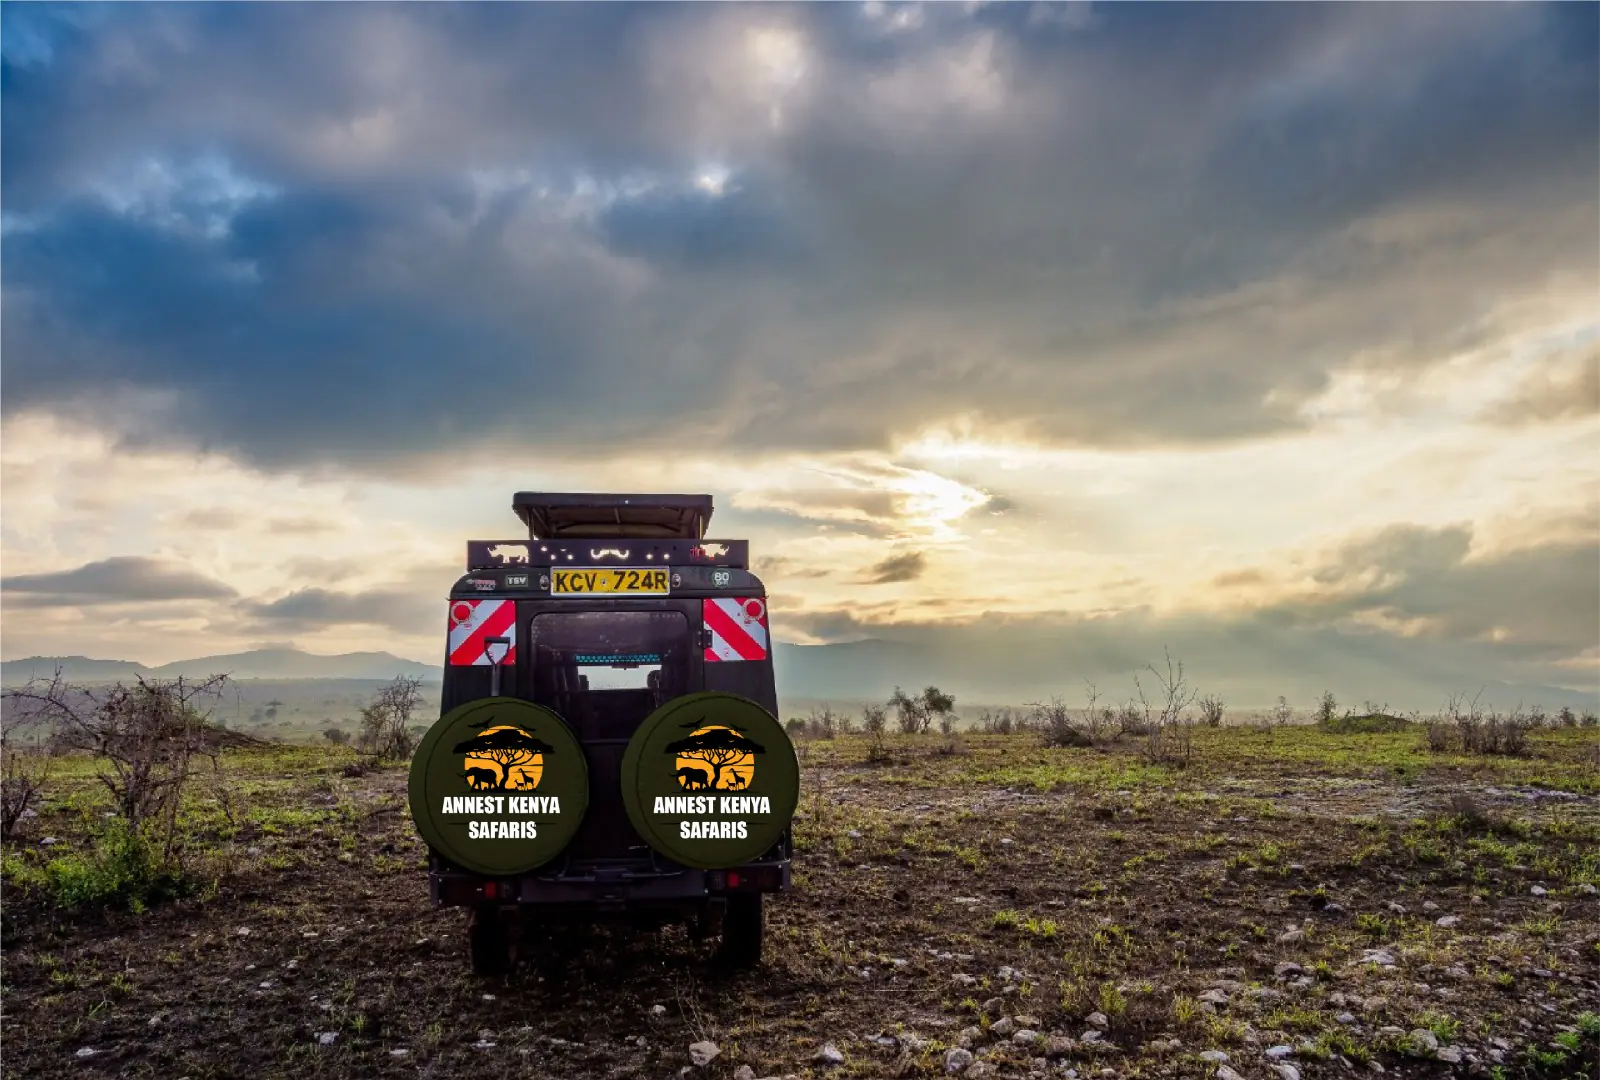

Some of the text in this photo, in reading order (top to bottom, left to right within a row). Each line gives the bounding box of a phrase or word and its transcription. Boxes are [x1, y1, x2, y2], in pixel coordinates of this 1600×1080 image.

[507, 576, 526, 585] TSV
[555, 570, 667, 592] KCV 724R
[714, 572, 730, 581] 80
[442, 796, 561, 814] ANNEST KENYA
[653, 796, 771, 814] ANNEST KENYA
[468, 821, 537, 839] SAFARIS
[679, 821, 748, 839] SAFARIS
